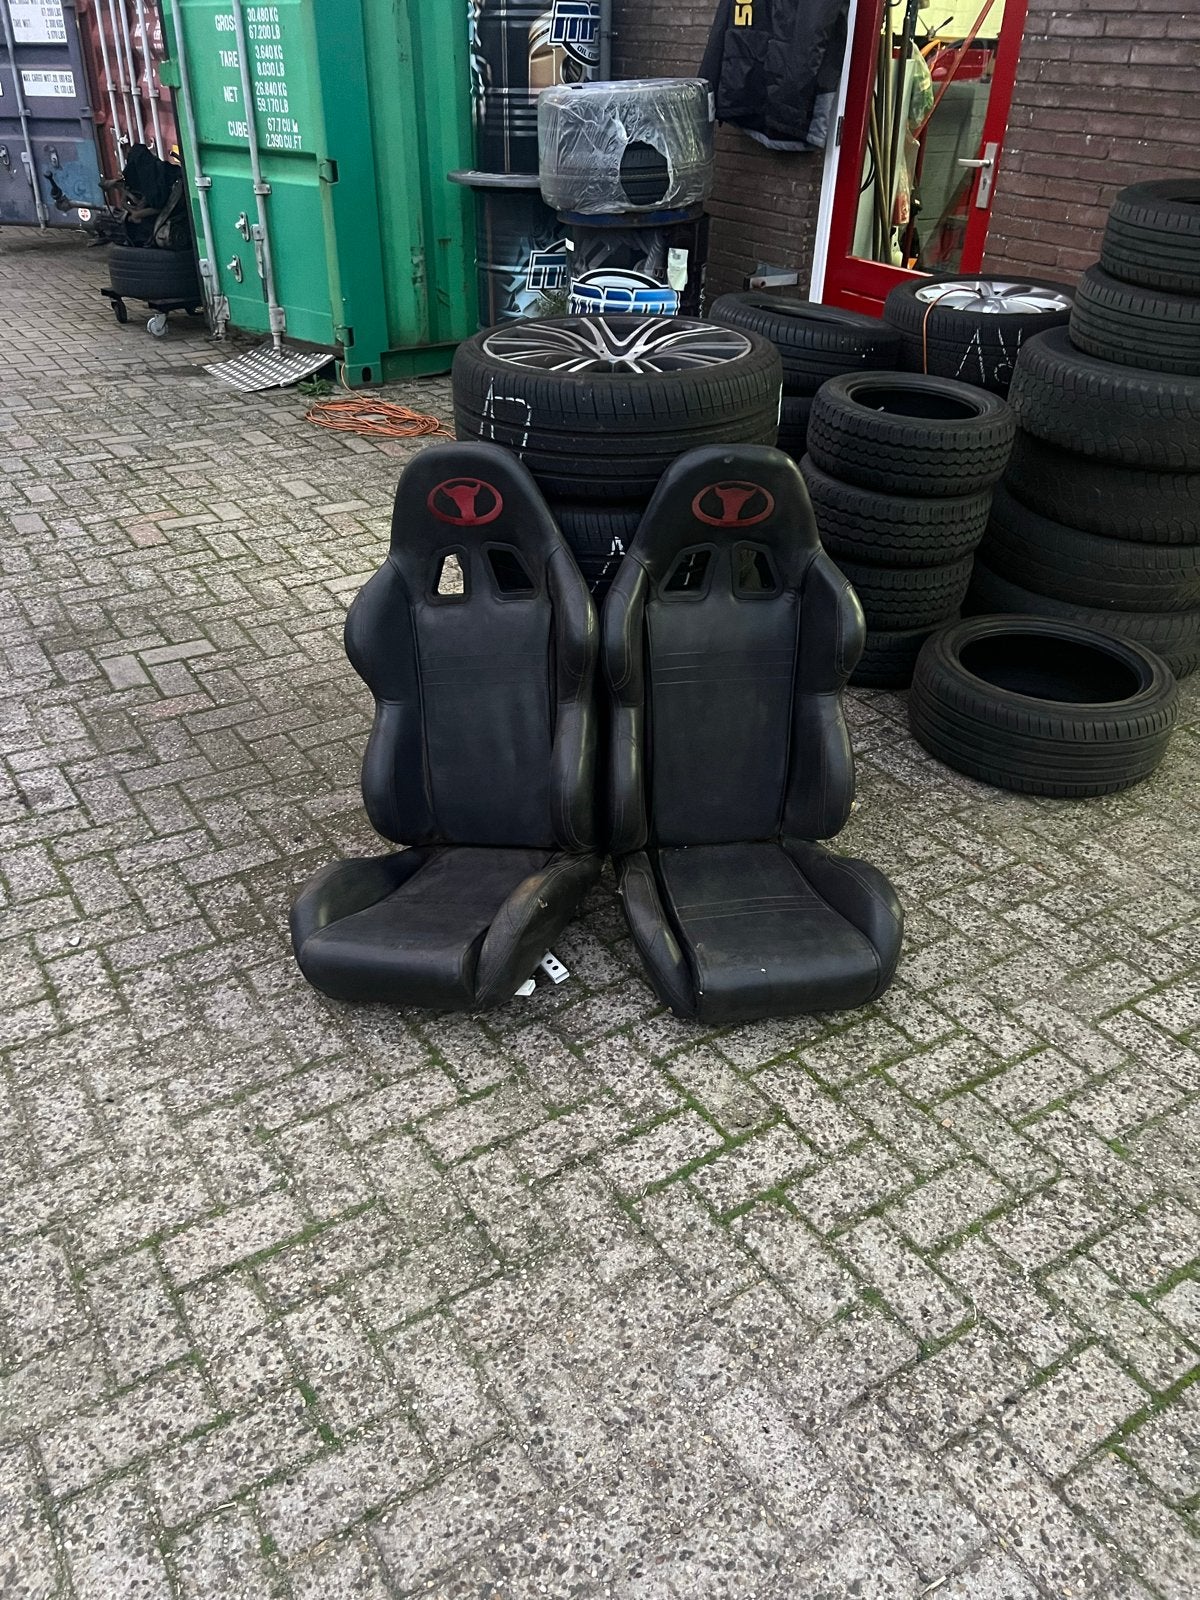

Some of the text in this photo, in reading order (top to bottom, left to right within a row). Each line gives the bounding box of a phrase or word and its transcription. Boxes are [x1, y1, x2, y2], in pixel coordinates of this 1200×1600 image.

[247, 7, 279, 23] 30.480 KG
[248, 25, 281, 40] 67.200 LB
[219, 51, 239, 68] TARE
[255, 45, 284, 60] 3.640 KG
[257, 62, 285, 77] 8.030 LB
[223, 86, 238, 102] NET
[255, 82, 288, 97] 26.840 KG
[257, 98, 289, 113] 59.170 LB
[228, 120, 249, 138] CUBE
